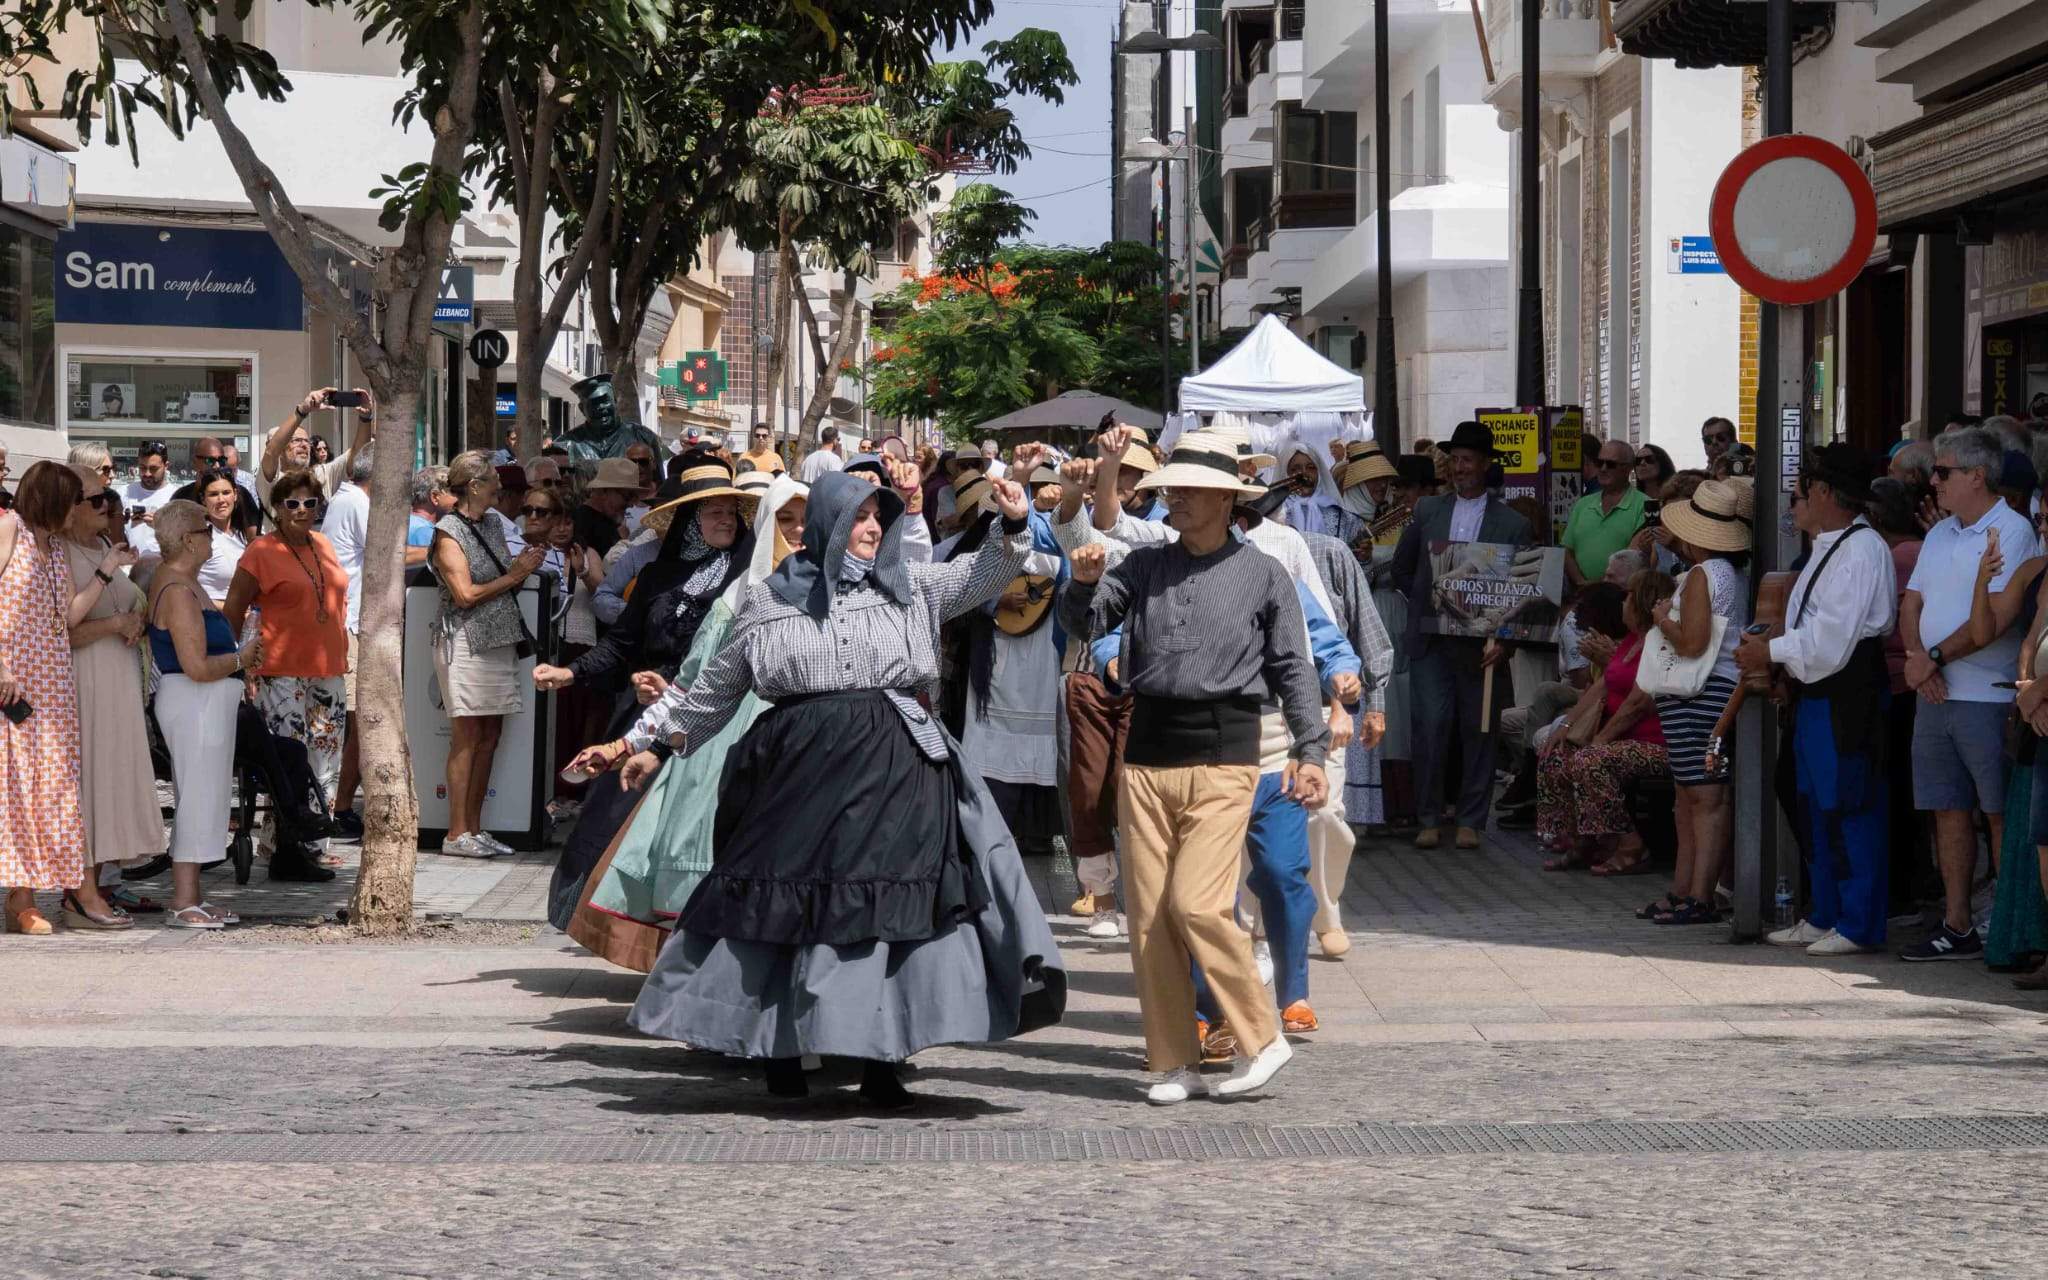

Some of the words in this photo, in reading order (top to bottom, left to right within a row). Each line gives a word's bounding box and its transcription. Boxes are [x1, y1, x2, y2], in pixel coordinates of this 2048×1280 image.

[65, 251, 155, 290] Sam
[163, 270, 257, 301] complements
[477, 338, 501, 360] IN
[1442, 578, 1484, 593] COROS
[1486, 581, 1493, 594] Y
[1494, 583, 1544, 597] DANZAS
[1464, 593, 1519, 608] ARRECIFE
